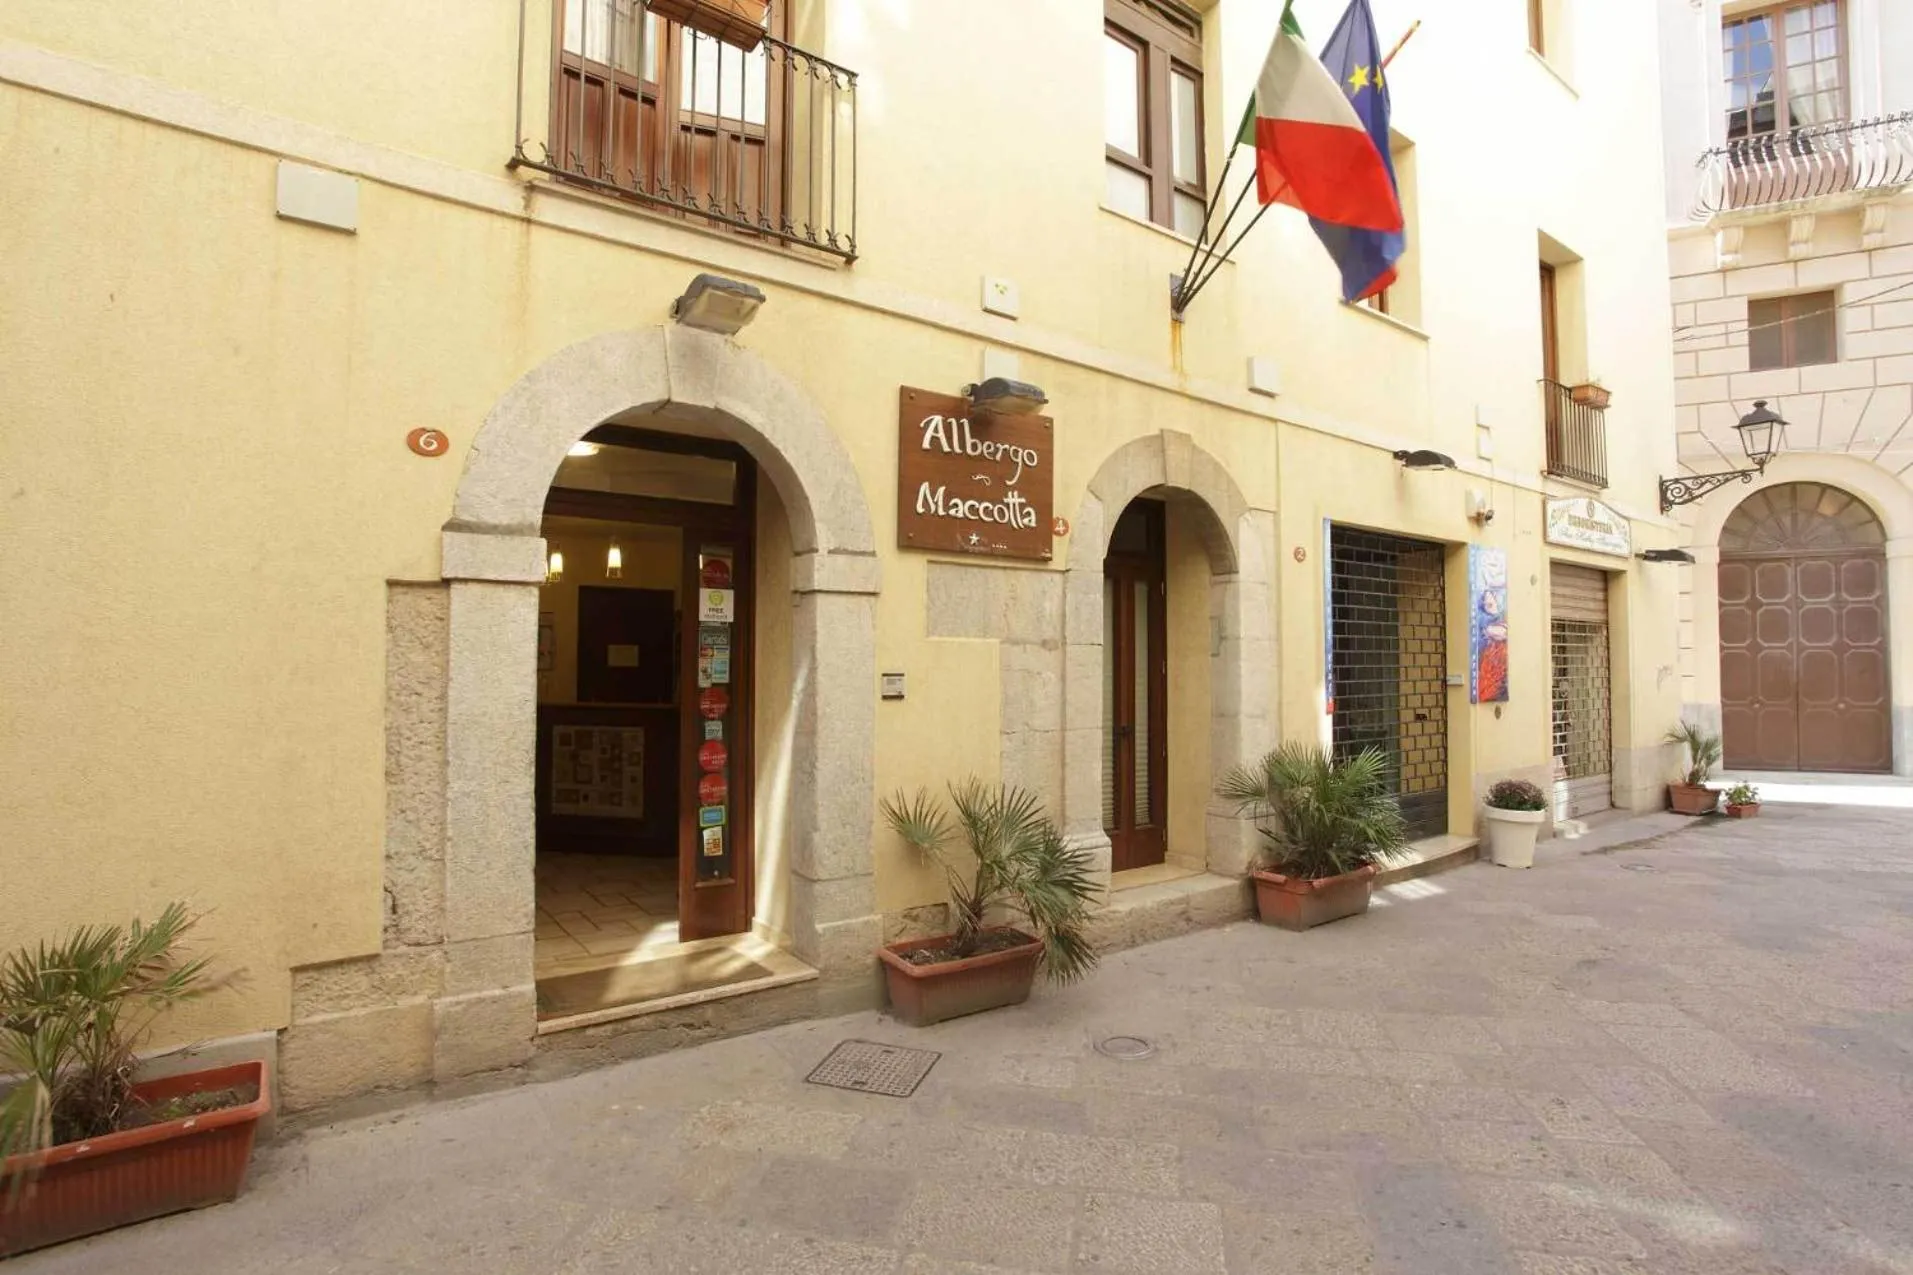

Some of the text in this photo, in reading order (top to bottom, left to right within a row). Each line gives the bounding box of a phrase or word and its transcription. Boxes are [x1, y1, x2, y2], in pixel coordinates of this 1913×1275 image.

[419, 431, 438, 451] 6
[919, 415, 1039, 486] Albergo
[916, 481, 1037, 530] Maccotta
[1054, 519, 1066, 535] 4
